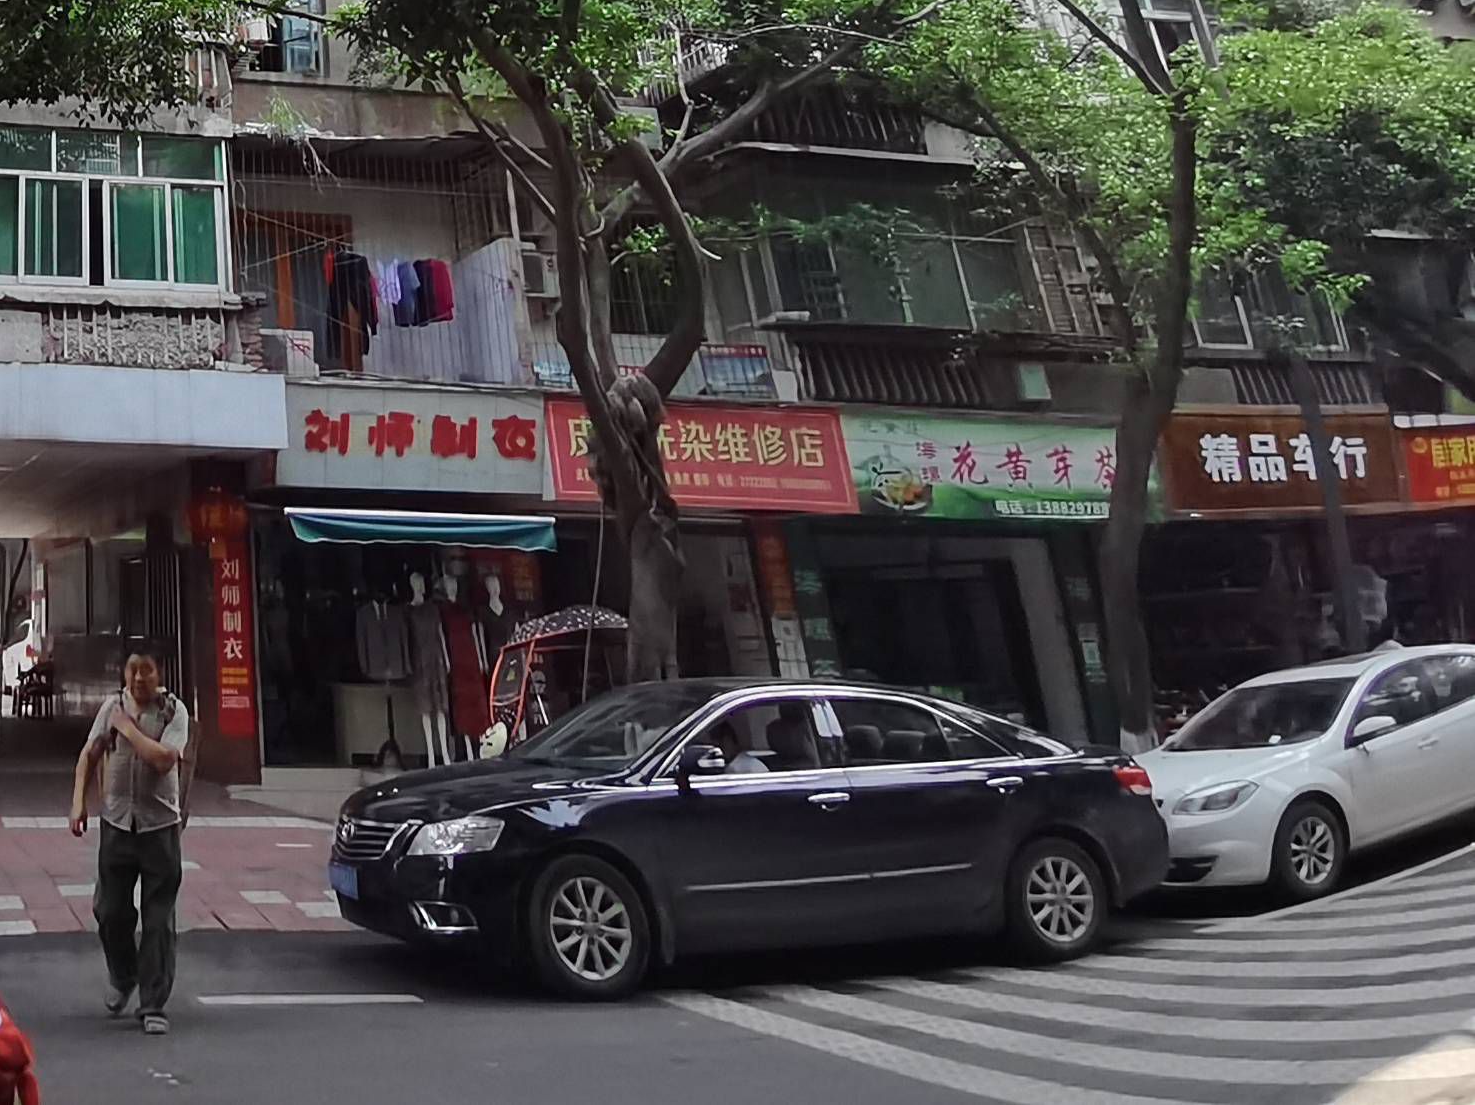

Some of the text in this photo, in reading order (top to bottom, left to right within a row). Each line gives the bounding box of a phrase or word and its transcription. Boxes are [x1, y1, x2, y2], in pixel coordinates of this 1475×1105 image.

[567, 415, 826, 468] 皮洗染维修店
[1199, 432, 1369, 484] 精品车行
[220, 557, 244, 661] 刘师制衣
